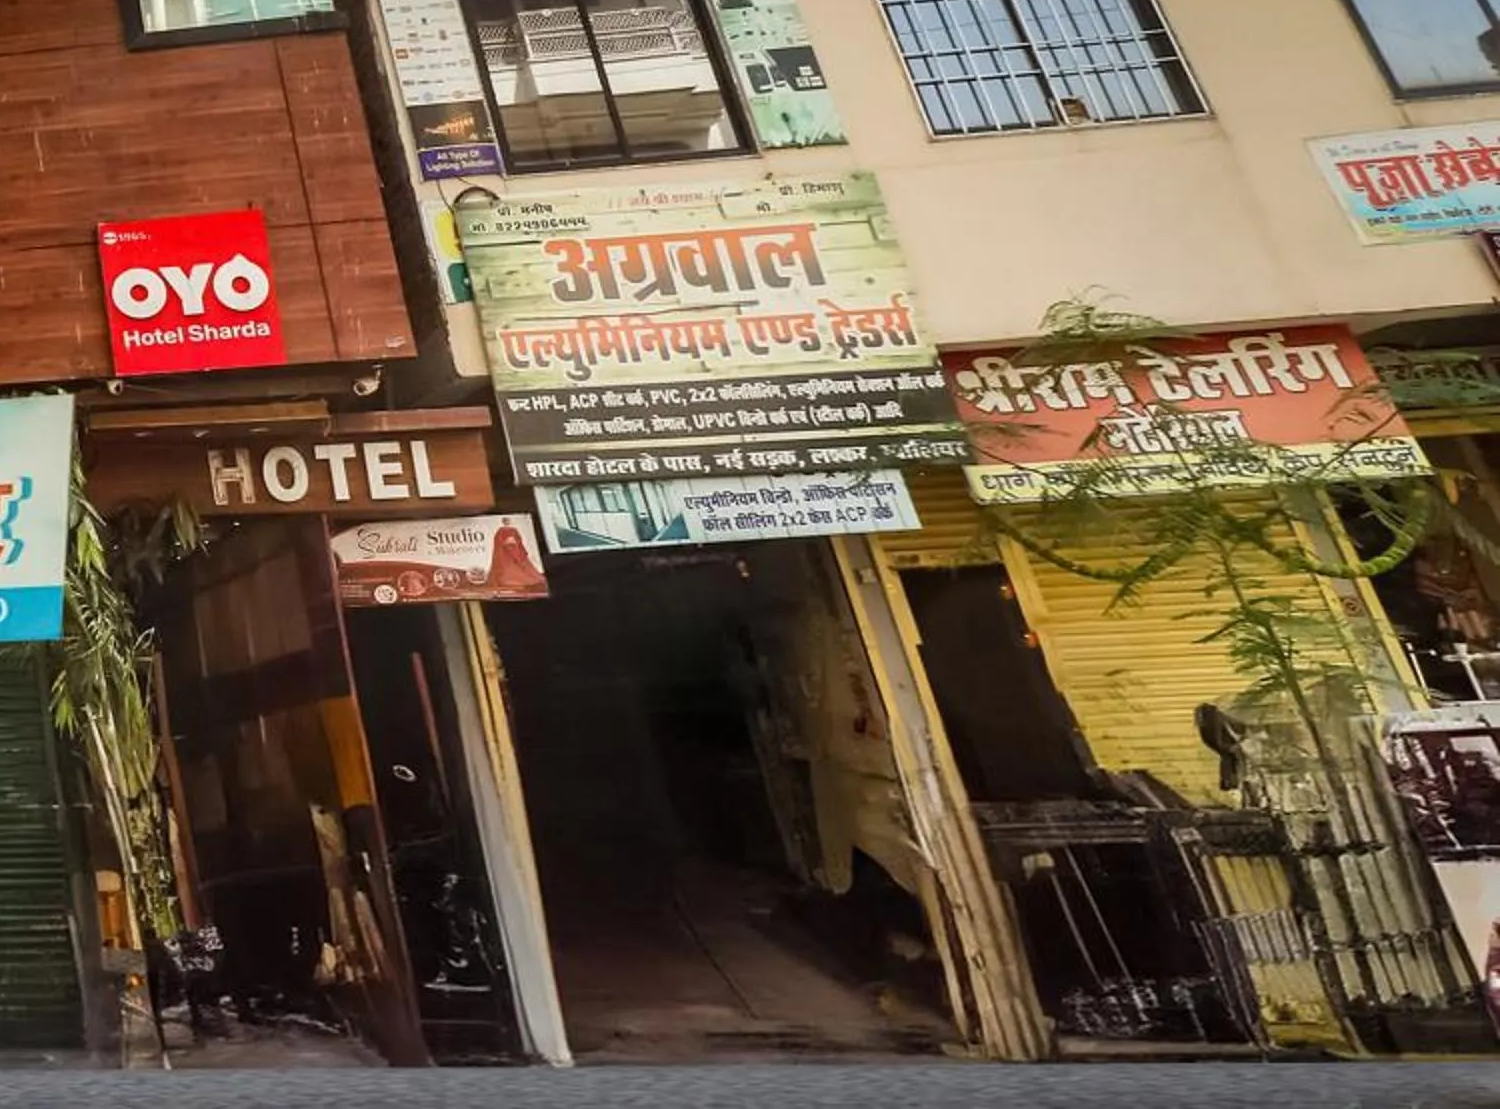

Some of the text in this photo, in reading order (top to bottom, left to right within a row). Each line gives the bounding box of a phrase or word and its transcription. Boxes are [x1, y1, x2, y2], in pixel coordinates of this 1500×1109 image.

[542, 223, 826, 302] अग्रवाल
[112, 253, 269, 320] OYO
[123, 321, 271, 350] Hotel Sharda
[499, 292, 918, 379] एल्युमिनियम एण्ड ट्रेडर्स
[1125, 332, 1354, 401] टेलरिंग
[532, 396, 567, 412] HPL,
[570, 393, 599, 410] ACP
[650, 389, 687, 406] PVC,
[690, 387, 718, 403] 2x2
[692, 412, 736, 430] UPVC
[207, 440, 456, 506] HOTEL
[525, 459, 581, 478] शारदा
[584, 456, 636, 476] होटल
[637, 453, 660, 472] के
[662, 454, 711, 474] पास,
[713, 448, 745, 470] नई
[781, 510, 808, 527] 2x2
[836, 506, 867, 523] ACP
[426, 529, 485, 545] Studio
